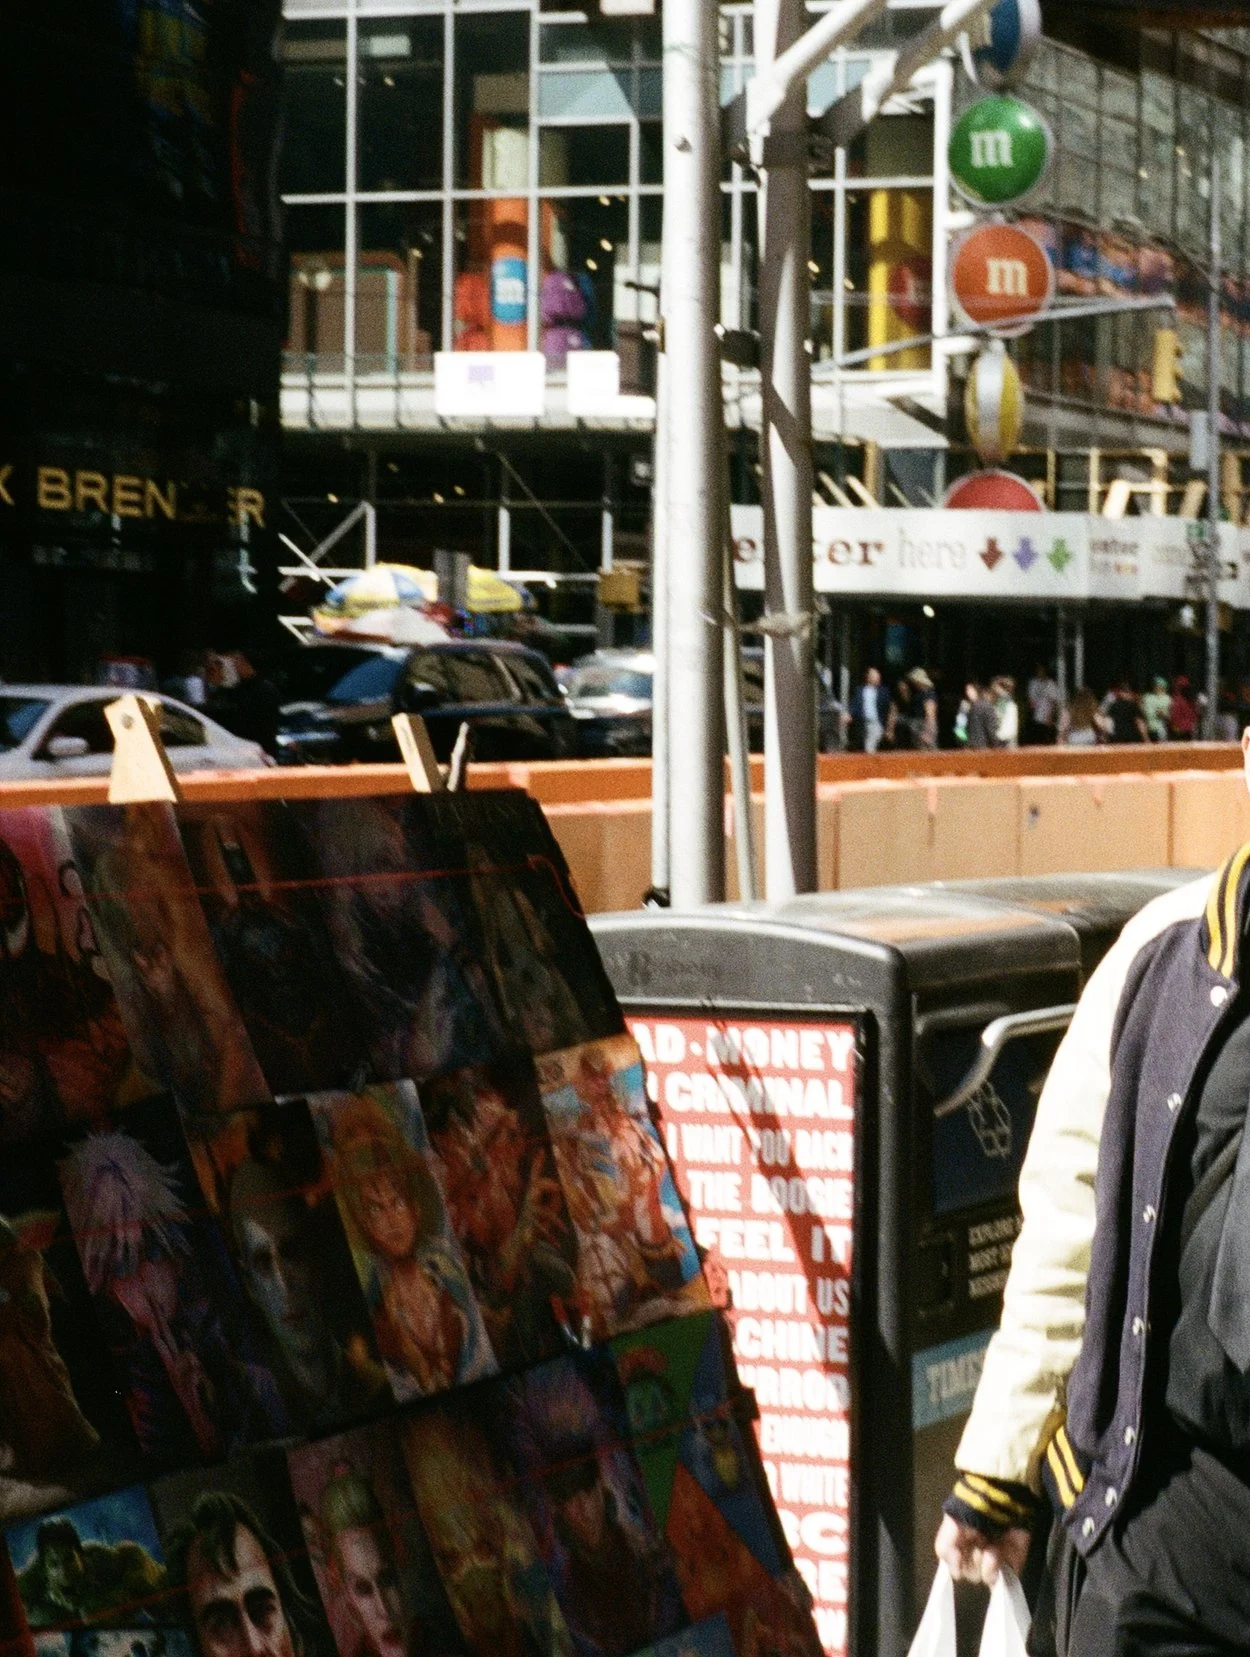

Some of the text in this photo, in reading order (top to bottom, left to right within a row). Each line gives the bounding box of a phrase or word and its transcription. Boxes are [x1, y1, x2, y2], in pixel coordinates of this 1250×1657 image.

[970, 130, 1014, 169] m
[987, 258, 1029, 297] m
[706, 1026, 853, 1072] MONEY
[665, 1072, 853, 1120] CRIMINAL
[681, 1123, 743, 1165] WANT
[747, 1126, 791, 1167] YOU
[795, 1129, 853, 1171] BACK
[687, 1169, 853, 1220] THE BOOGIE
[696, 1216, 853, 1265] FEEL IT
[816, 1276, 850, 1317] US
[733, 1317, 849, 1364] CHINE
